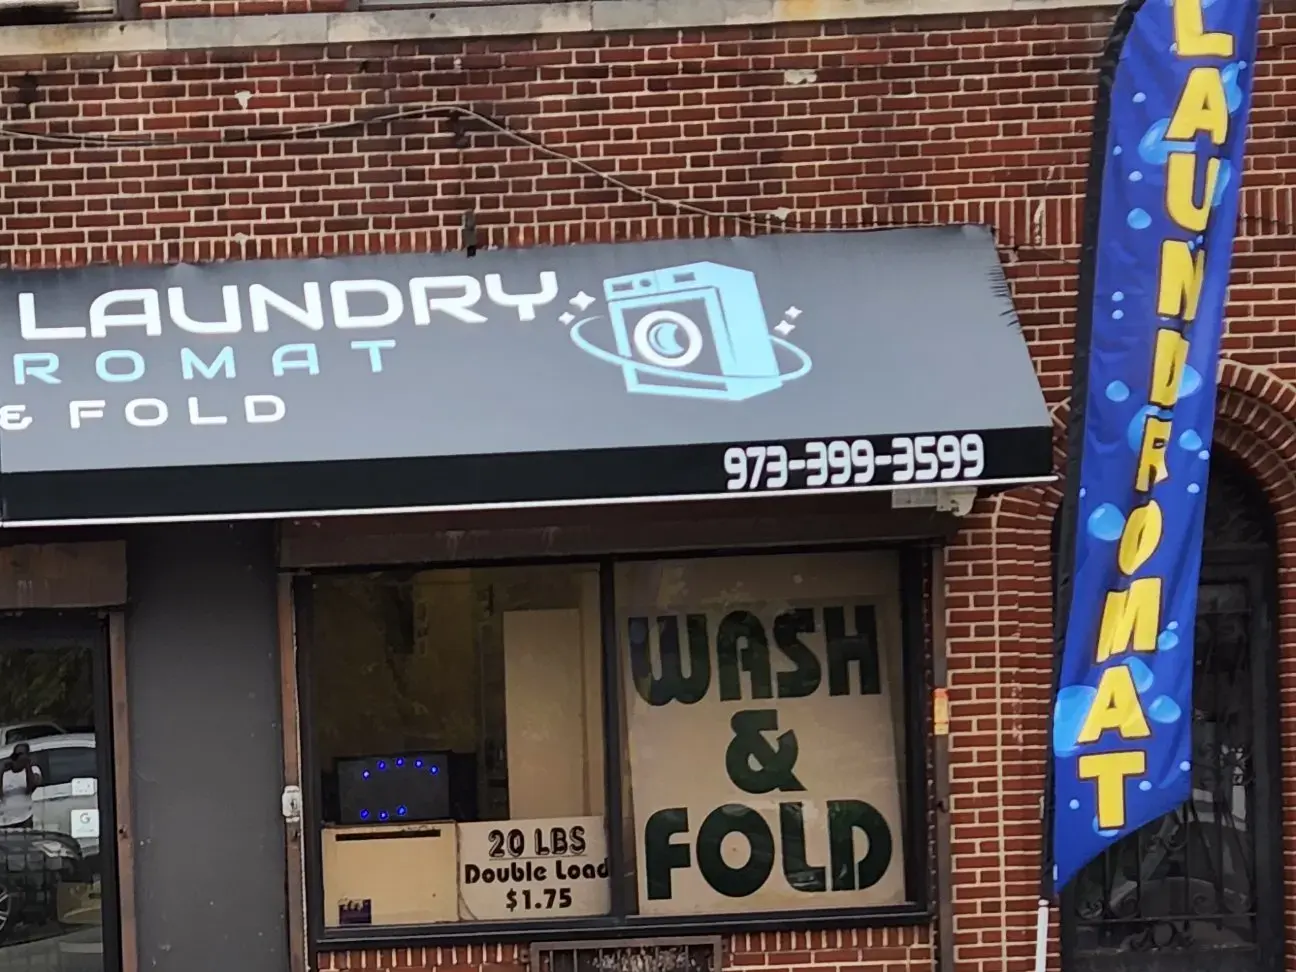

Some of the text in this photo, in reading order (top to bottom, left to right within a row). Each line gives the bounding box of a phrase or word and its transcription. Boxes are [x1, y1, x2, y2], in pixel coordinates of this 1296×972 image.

[18, 271, 559, 340] LAUNDRY
[69, 394, 286, 429] FOLD
[1078, 0, 1234, 829] LAUNDROMAT
[724, 433, 984, 490] 973-399-3599
[626, 605, 882, 707] WASH
[725, 709, 807, 794] &
[464, 858, 609, 884] Double Load
[488, 825, 586, 858] 20 LBS
[644, 799, 893, 901] FOLD
[505, 887, 573, 912] $1.75
